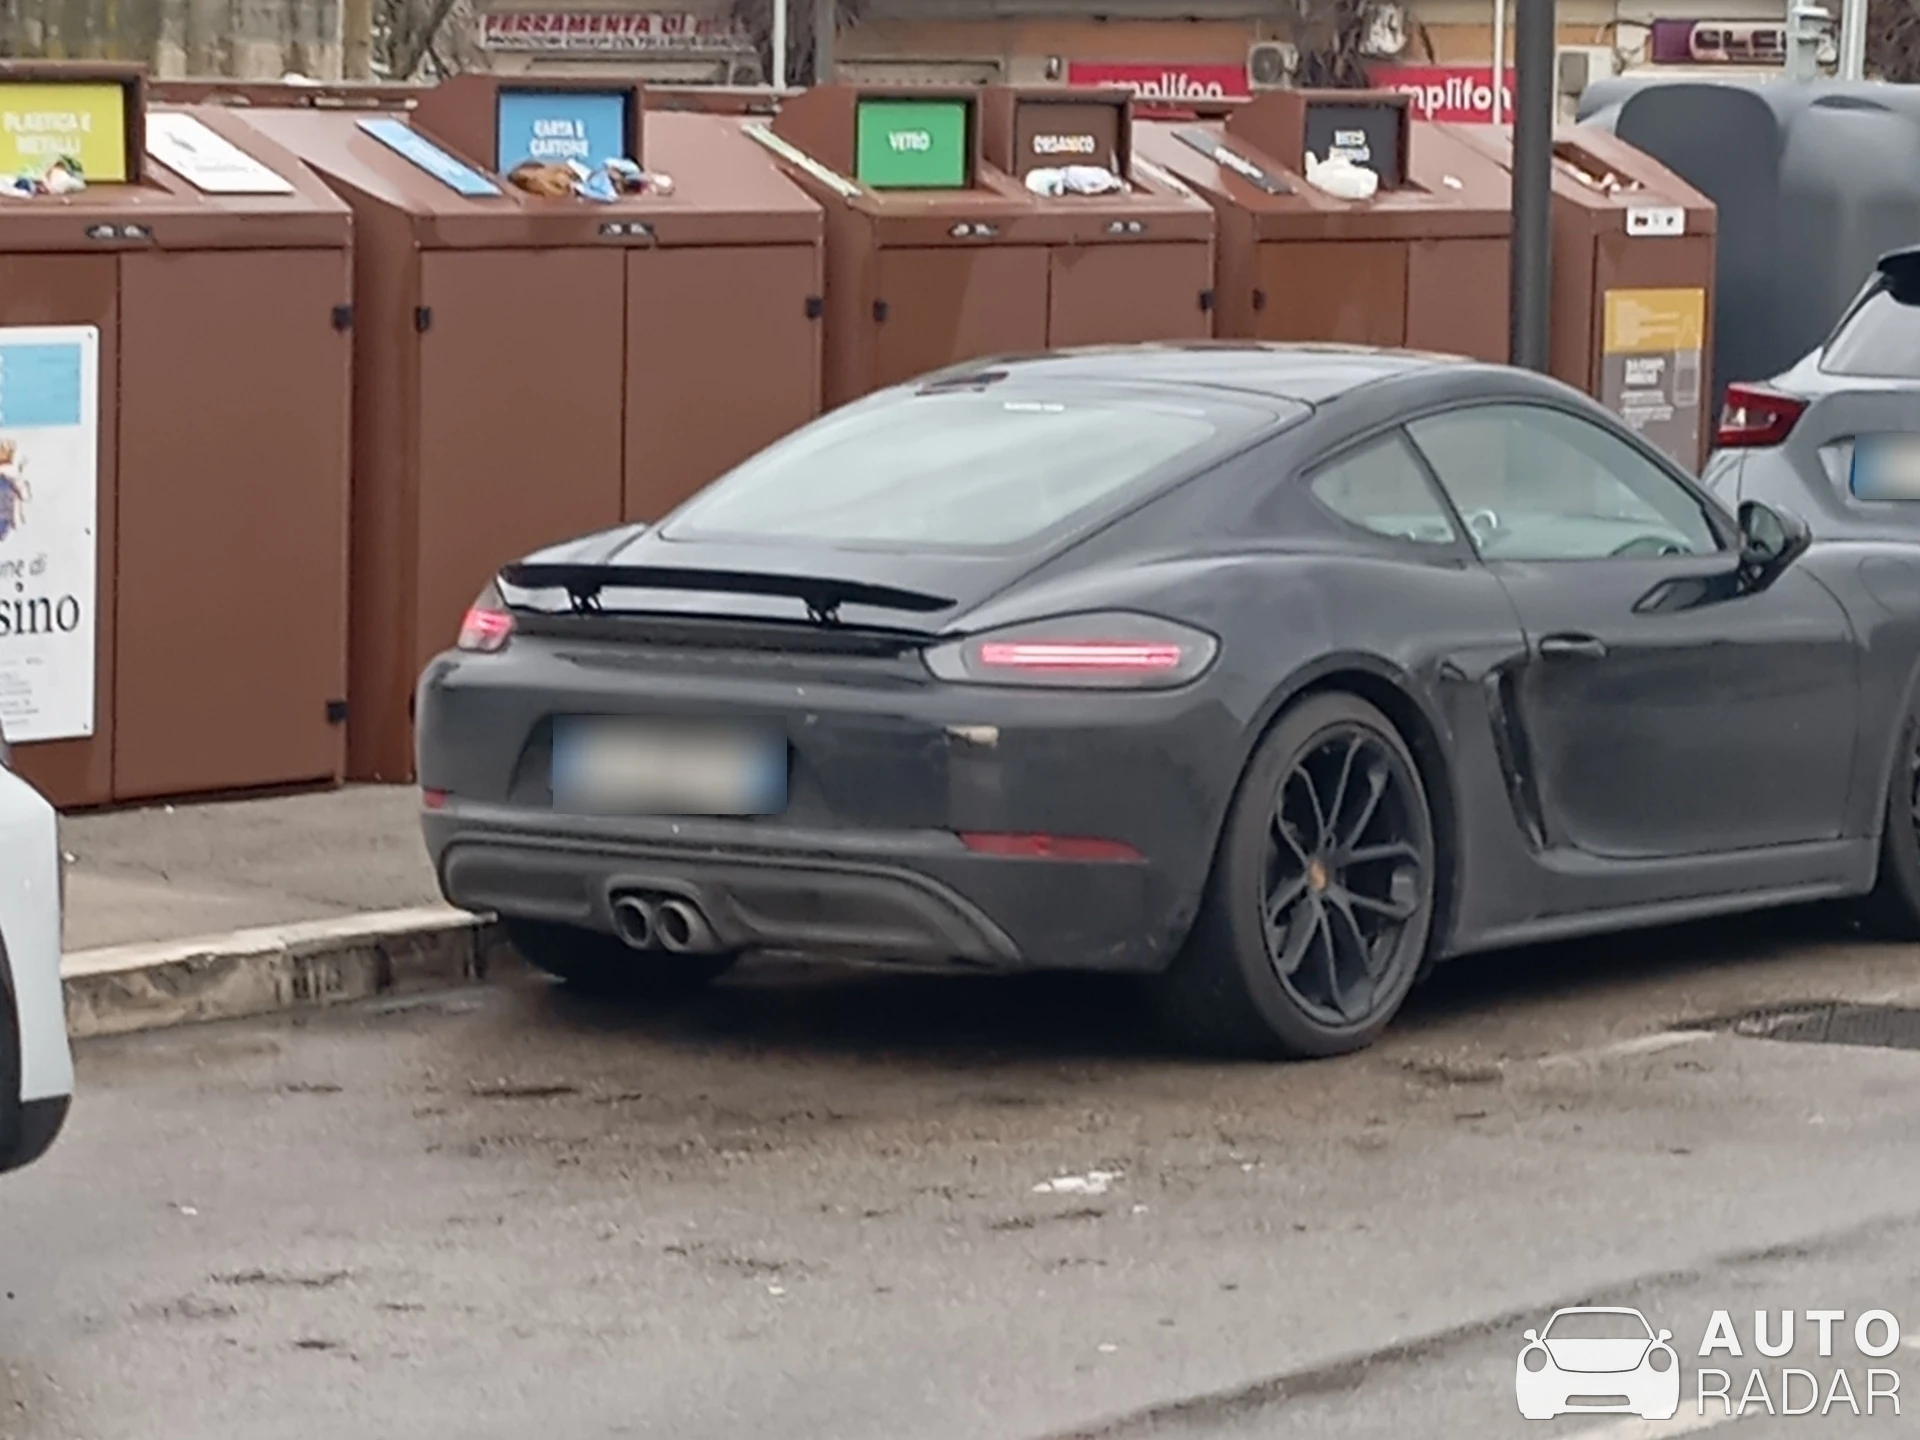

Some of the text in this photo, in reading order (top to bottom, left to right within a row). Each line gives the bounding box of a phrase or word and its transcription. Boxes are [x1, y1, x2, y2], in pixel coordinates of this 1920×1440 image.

[485, 14, 650, 34] FERRAMENTA
[1098, 72, 1222, 99] mplifon
[1387, 76, 1512, 120] mplifon
[533, 119, 574, 137] CARTA
[887, 130, 931, 151] VETRO
[1032, 135, 1096, 154] ORGANICO
